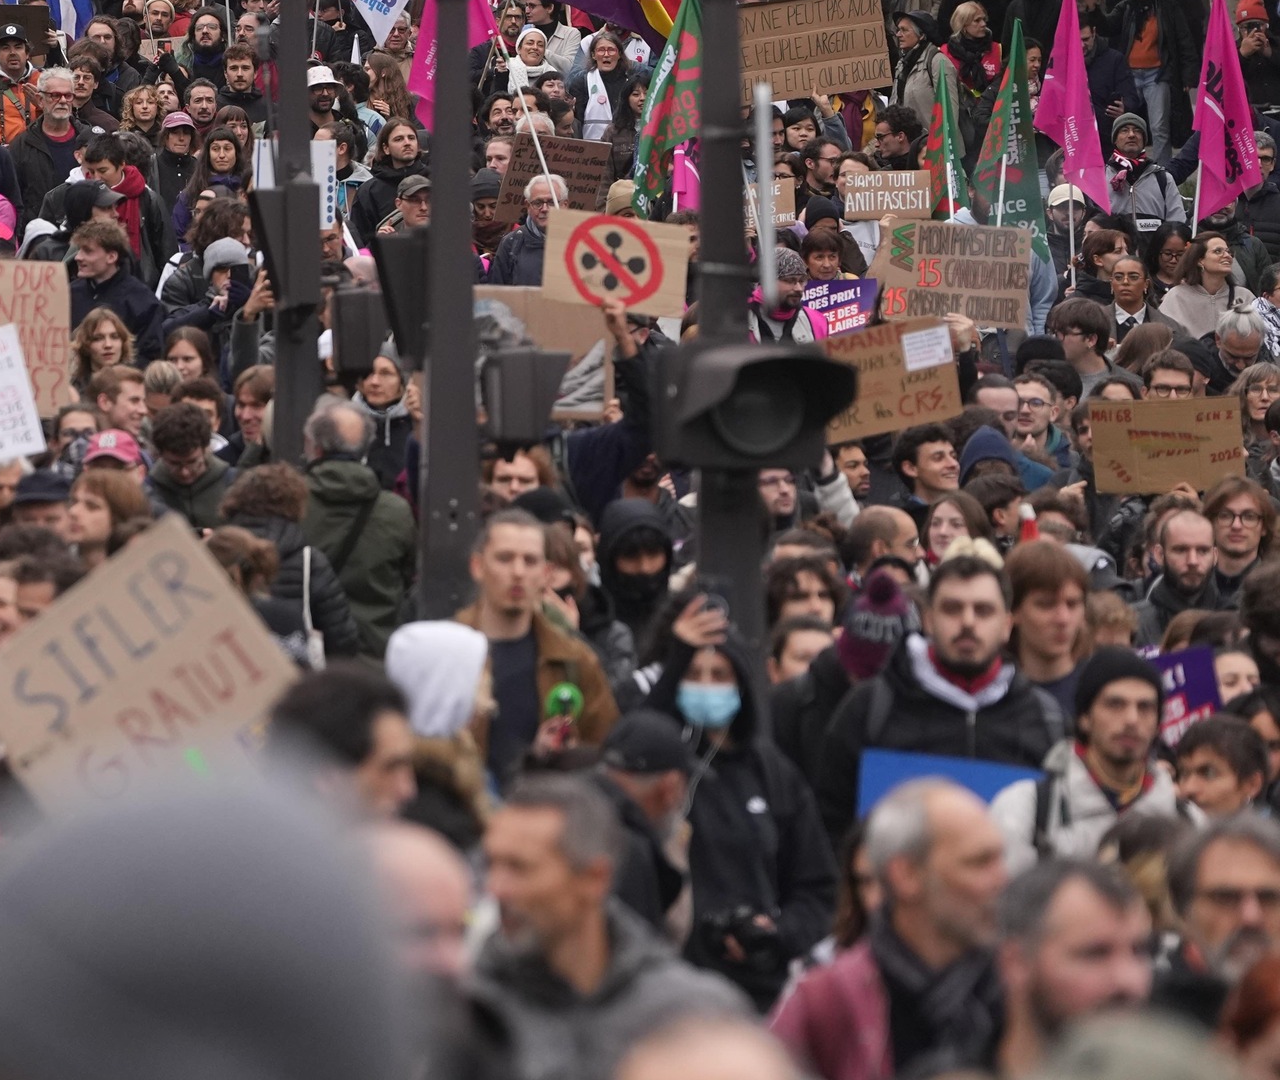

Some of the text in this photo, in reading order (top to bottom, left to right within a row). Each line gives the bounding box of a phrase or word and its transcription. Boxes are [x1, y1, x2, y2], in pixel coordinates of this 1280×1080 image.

[760, 7, 782, 31] NE
[786, 0, 824, 26] PEUT
[863, 26, 884, 49] DU
[784, 70, 800, 92] ET
[800, 67, 815, 91] LE
[818, 67, 837, 89] CUL
[838, 65, 851, 86] DE
[546, 140, 585, 154] DU NORD
[948, 228, 1017, 258] MASTER
[13, 262, 57, 293] DUR
[917, 258, 1029, 290] 15 CANDIDATURES
[808, 296, 829, 311] DES
[830, 289, 855, 306] PRIX
[837, 304, 858, 318] DES
[884, 287, 907, 316] 15
[1091, 409, 1132, 423] MAI 68
[1210, 446, 1241, 463] 2026
[11, 549, 215, 737] SIFLER
